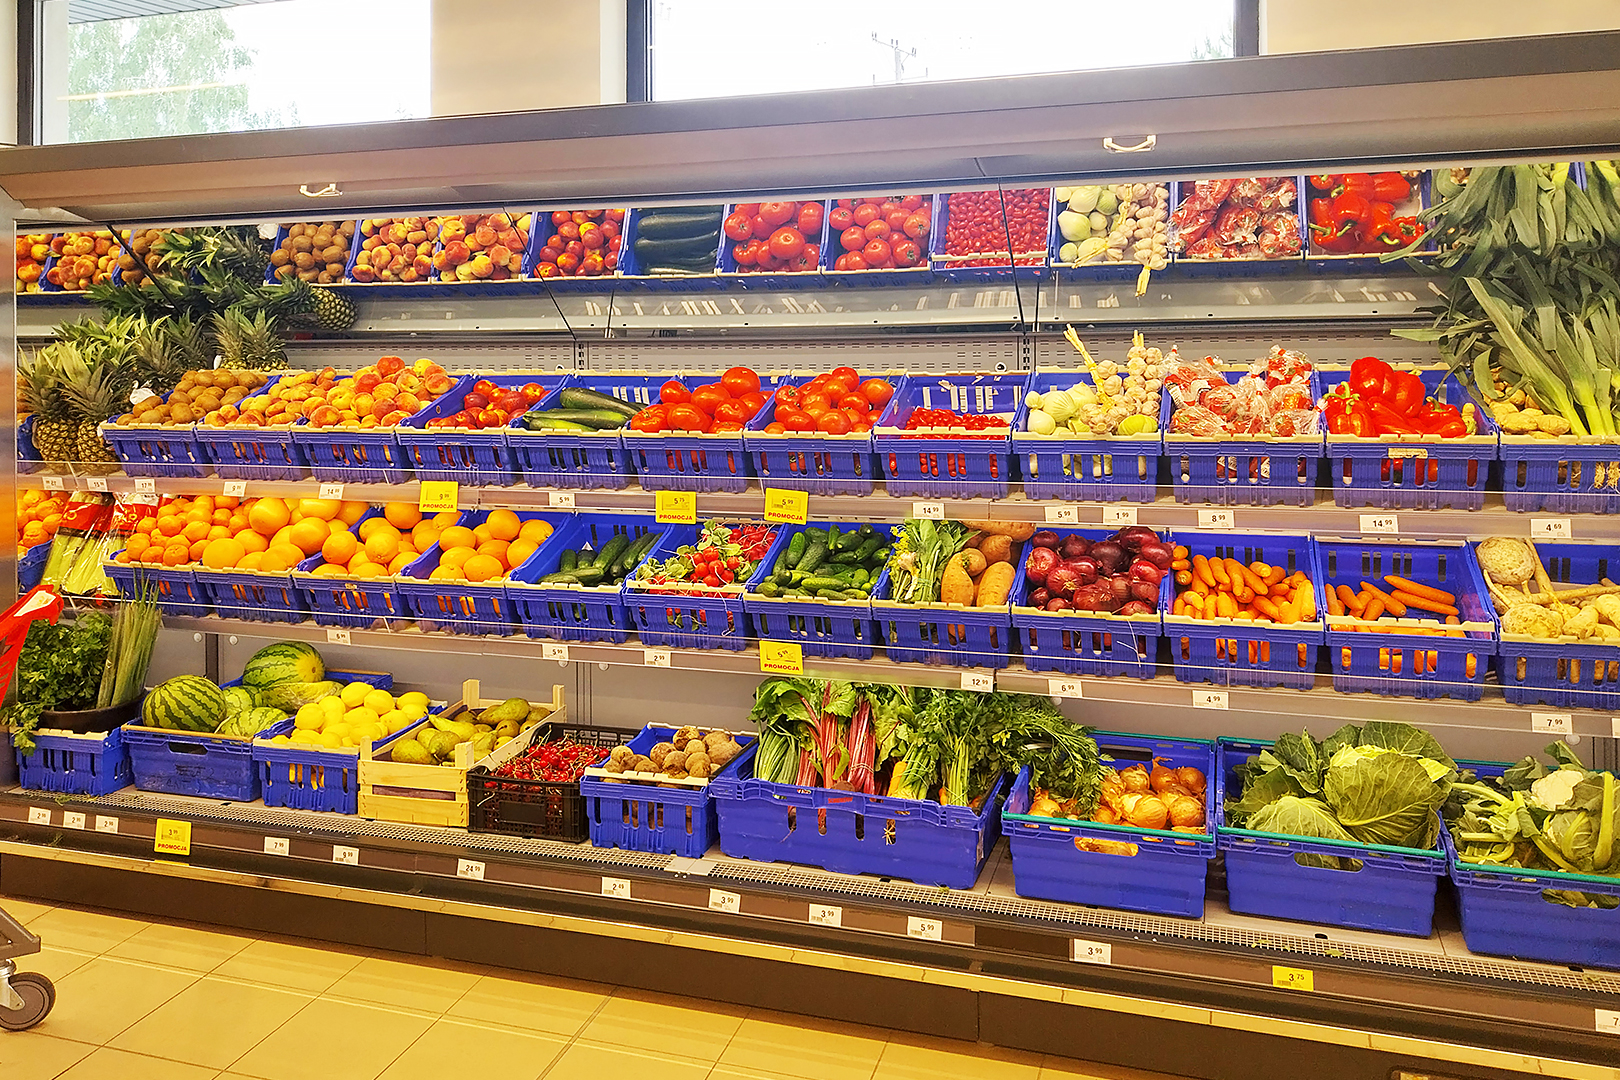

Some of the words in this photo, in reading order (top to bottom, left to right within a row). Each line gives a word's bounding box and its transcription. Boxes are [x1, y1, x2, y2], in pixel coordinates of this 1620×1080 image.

[768, 512, 804, 521] PROMOCJA
[764, 663, 800, 671] PROMOCJA
[158, 843, 187, 851] PROMOCJA
